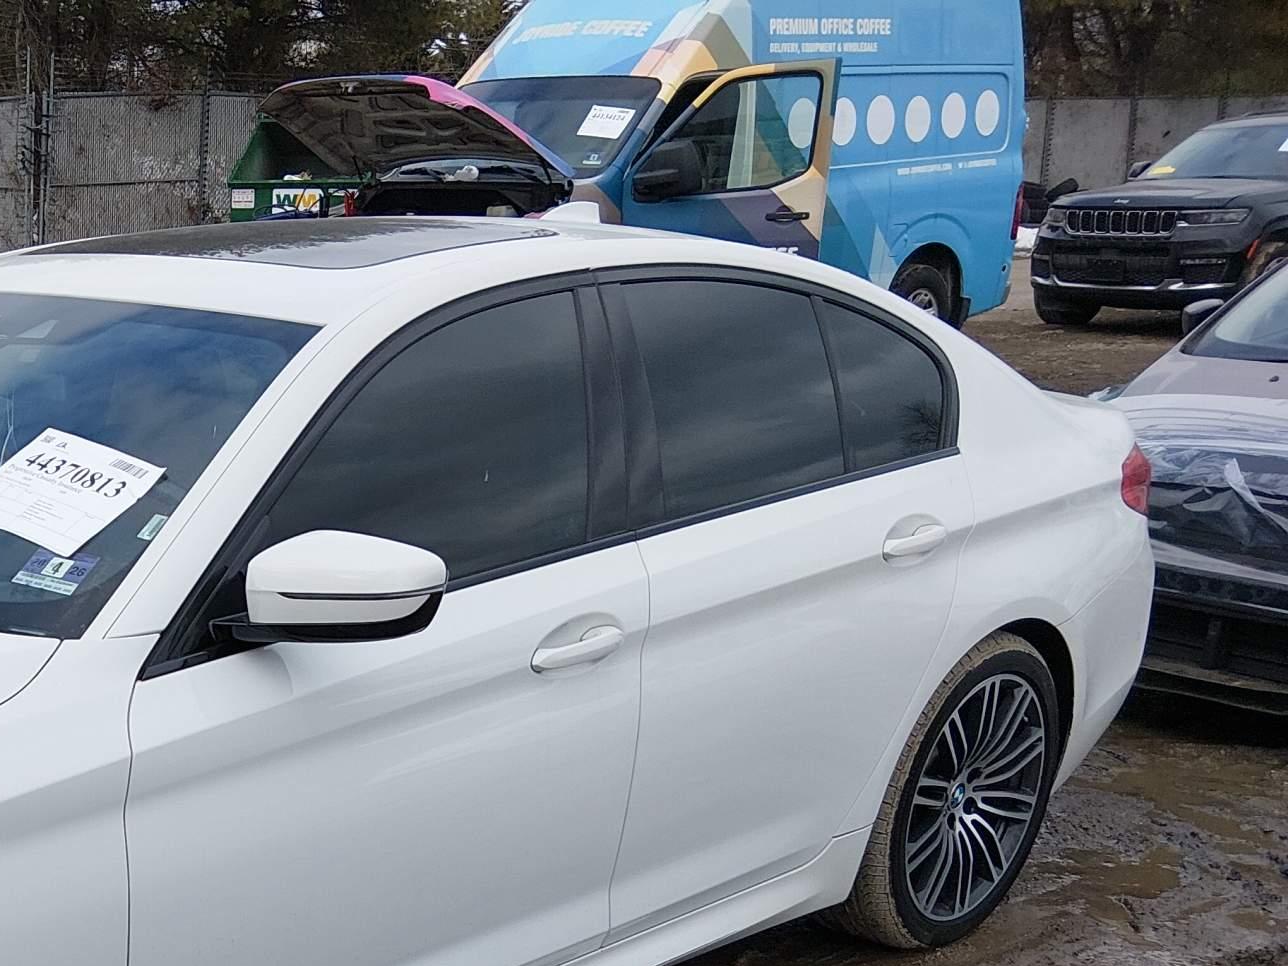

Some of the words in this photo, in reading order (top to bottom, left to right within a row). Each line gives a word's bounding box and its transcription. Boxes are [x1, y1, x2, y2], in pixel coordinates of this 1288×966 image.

[581, 19, 653, 38] COFFEE
[770, 18, 818, 35] PREMIUM
[821, 18, 854, 35] OFFICE
[856, 18, 892, 35] COFFEE
[769, 42, 800, 54] DELIVERY,
[276, 193, 317, 208] WM
[25, 452, 127, 498] 44370813
[69, 566, 87, 577] 26
